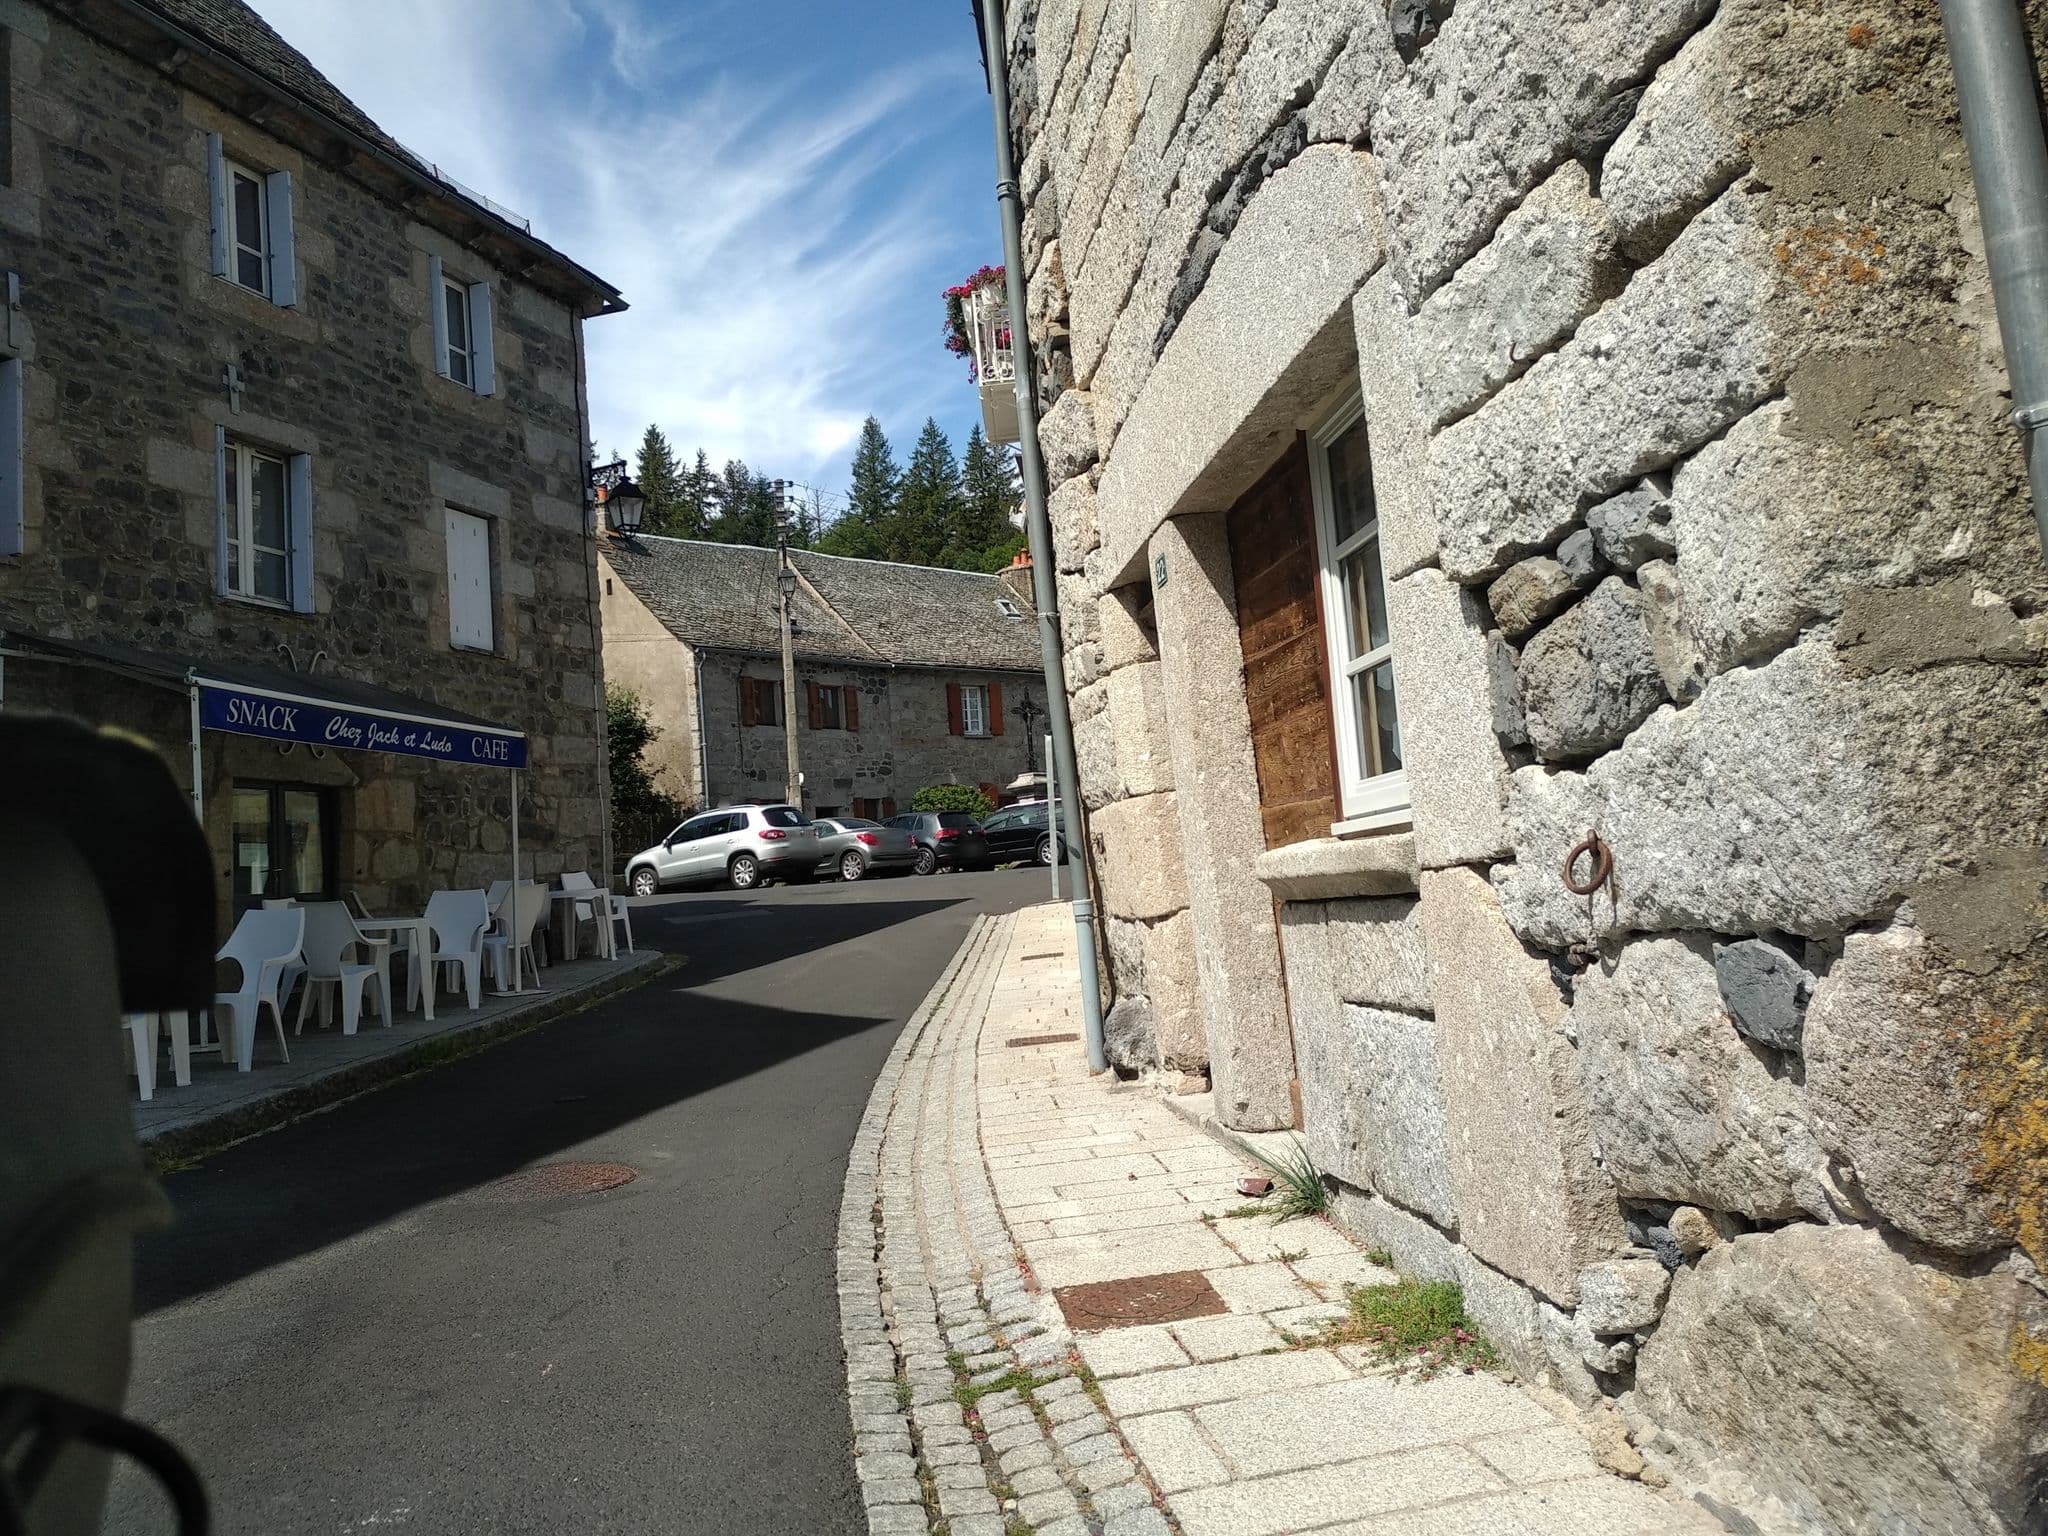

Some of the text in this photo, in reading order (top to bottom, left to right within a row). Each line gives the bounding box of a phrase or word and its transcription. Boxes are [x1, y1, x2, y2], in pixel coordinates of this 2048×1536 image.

[226, 698, 509, 761] SNACK Chez Jack et Ludo CAFE
